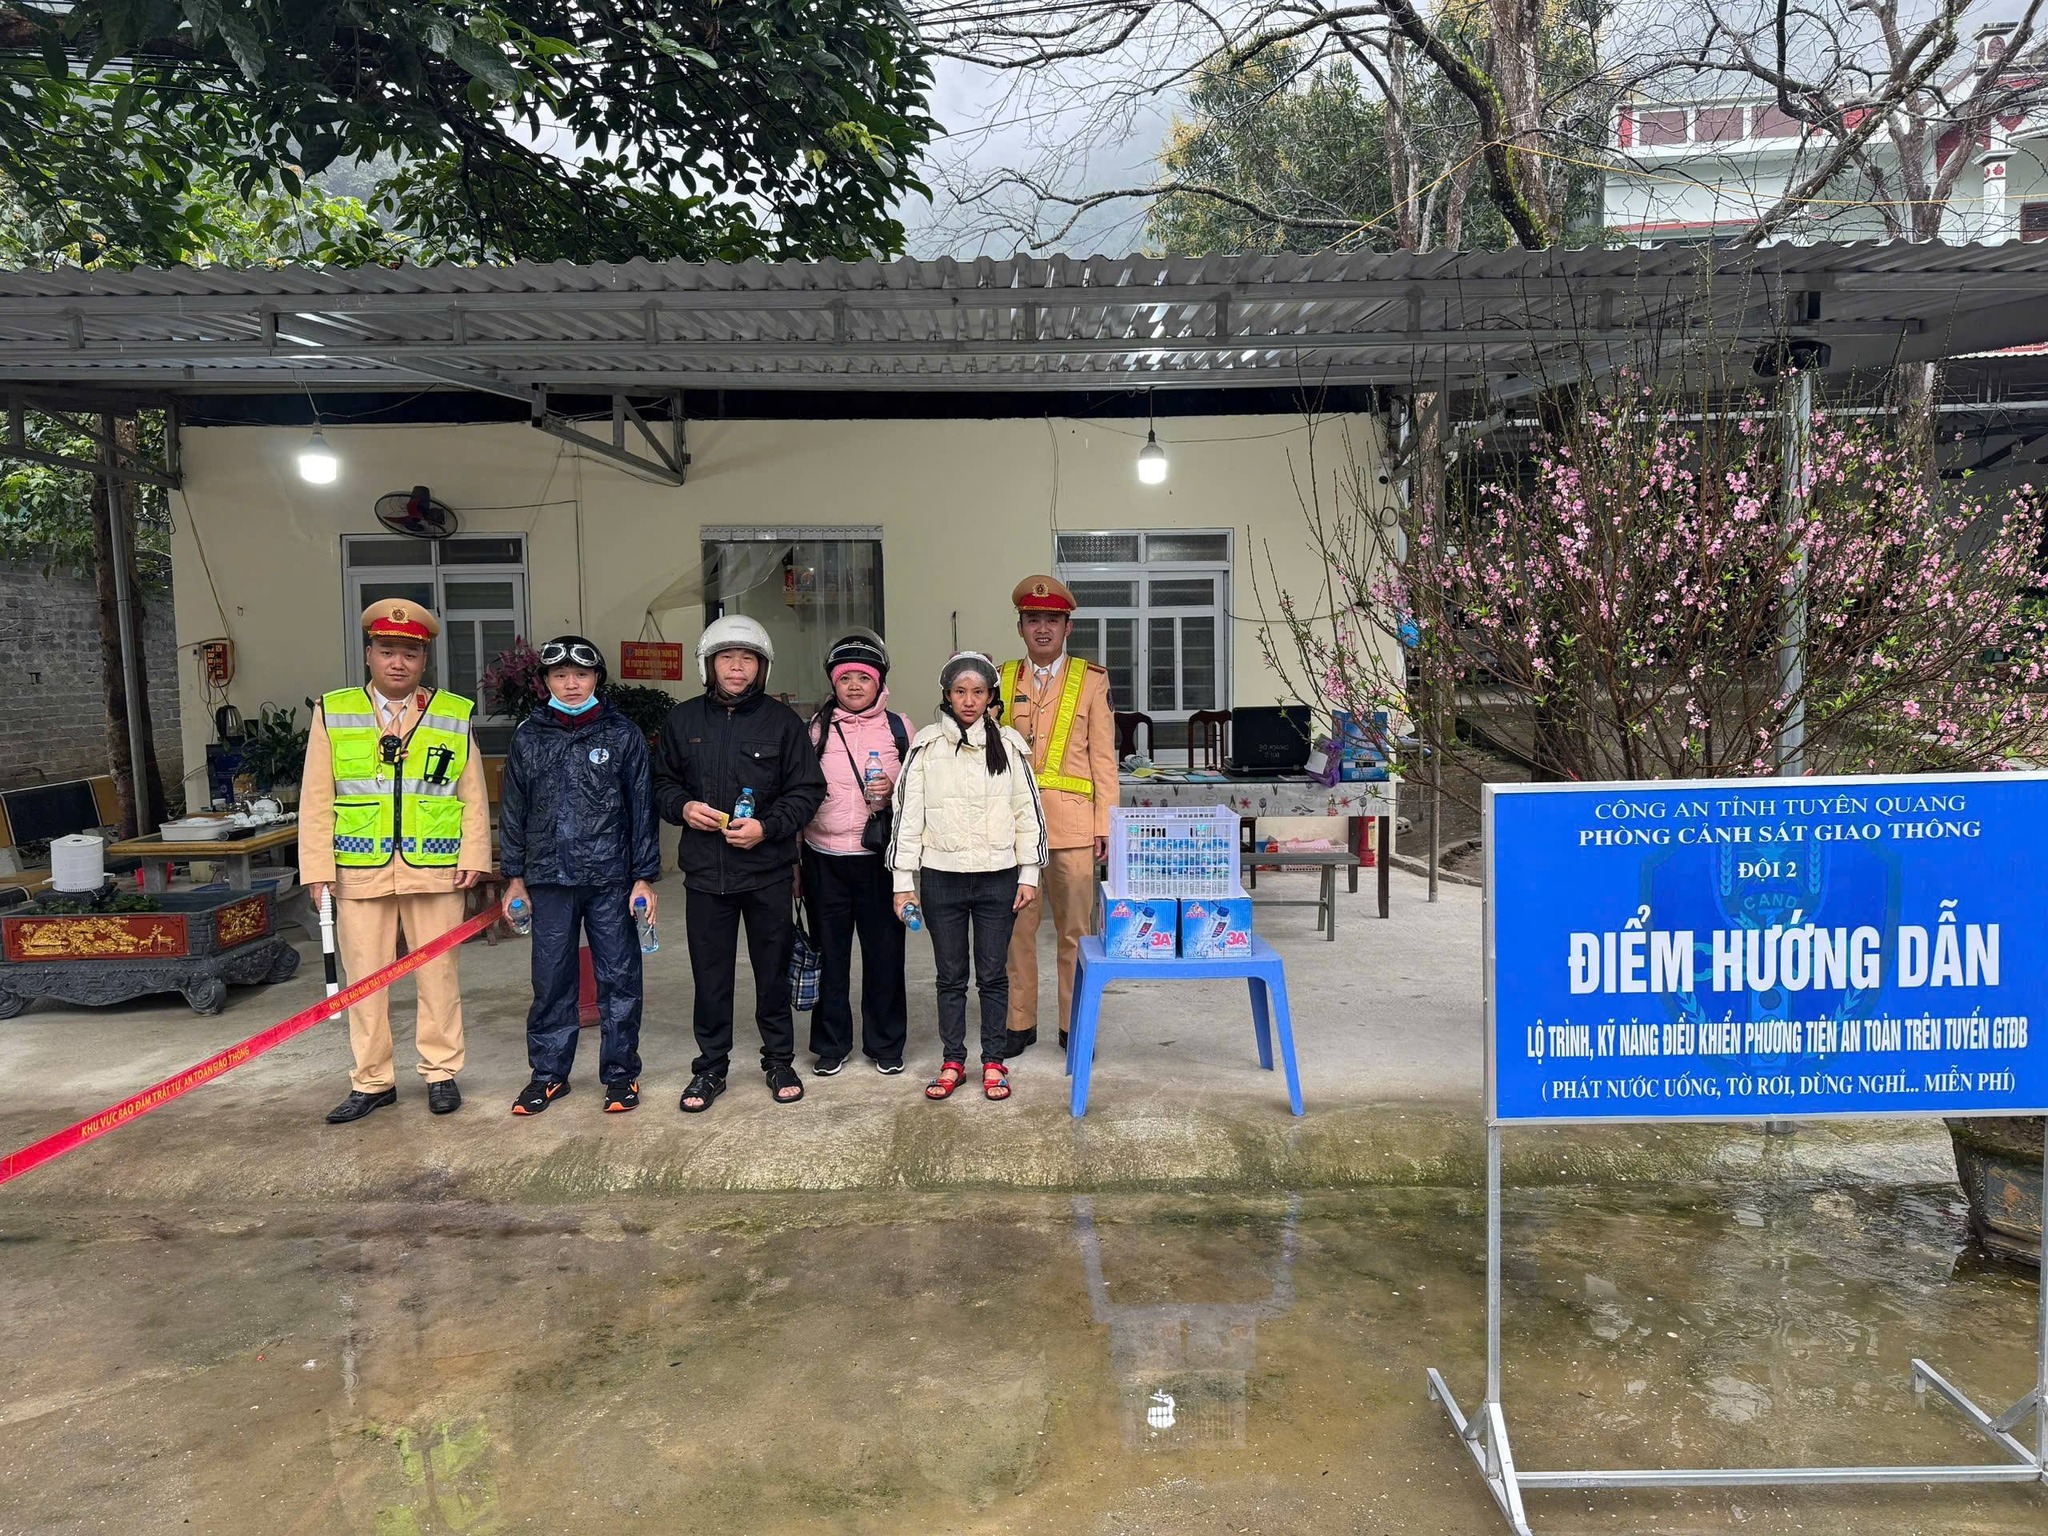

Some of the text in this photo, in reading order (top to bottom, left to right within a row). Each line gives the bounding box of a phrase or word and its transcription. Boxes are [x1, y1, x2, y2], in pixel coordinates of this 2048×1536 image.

[1595, 795, 1966, 819] CÔNG AN TỈNH TUYÊN QUANG
[1578, 818, 1982, 846] PHÒNG CẢNH SÁT GIAO THÔNG
[1737, 858, 1797, 882] ĐỘI 2
[1743, 893, 1798, 910] CAND
[1150, 932, 1172, 947] 3A
[1225, 931, 1248, 947] 3A
[1568, 905, 1694, 994] ĐIỂM
[1712, 908, 1880, 992] HƯỚNG
[1898, 899, 2000, 988] DẪN
[1527, 1006, 2029, 1065] LỘ TRÌNH, KỸ NĂNG ĐIỀU KHIỂN PHƯƠNG TIỆN AN TOÀN TRÊN TUYẾN GTĐB
[81, 1122, 99, 1137] KHU
[100, 1111, 118, 1129] VỰC
[183, 1075, 194, 1088] AN
[193, 1064, 213, 1082] TOÀN
[212, 1057, 228, 1073] GIAO
[228, 1045, 250, 1066] THÔNG
[1553, 1075, 1602, 1099] PHÁT
[1607, 1075, 1659, 1098] NƯỚC
[1664, 1071, 1721, 1100] UỐNG,
[1726, 1073, 1752, 1096] TỜ
[1757, 1075, 1795, 1098] RƠI,
[1800, 1071, 1853, 1095] DỪNG
[1858, 1068, 1920, 1094] NGHỈ...
[1924, 1064, 1973, 1093] MIỄN
[1978, 1067, 2016, 1094] PHÍ)
